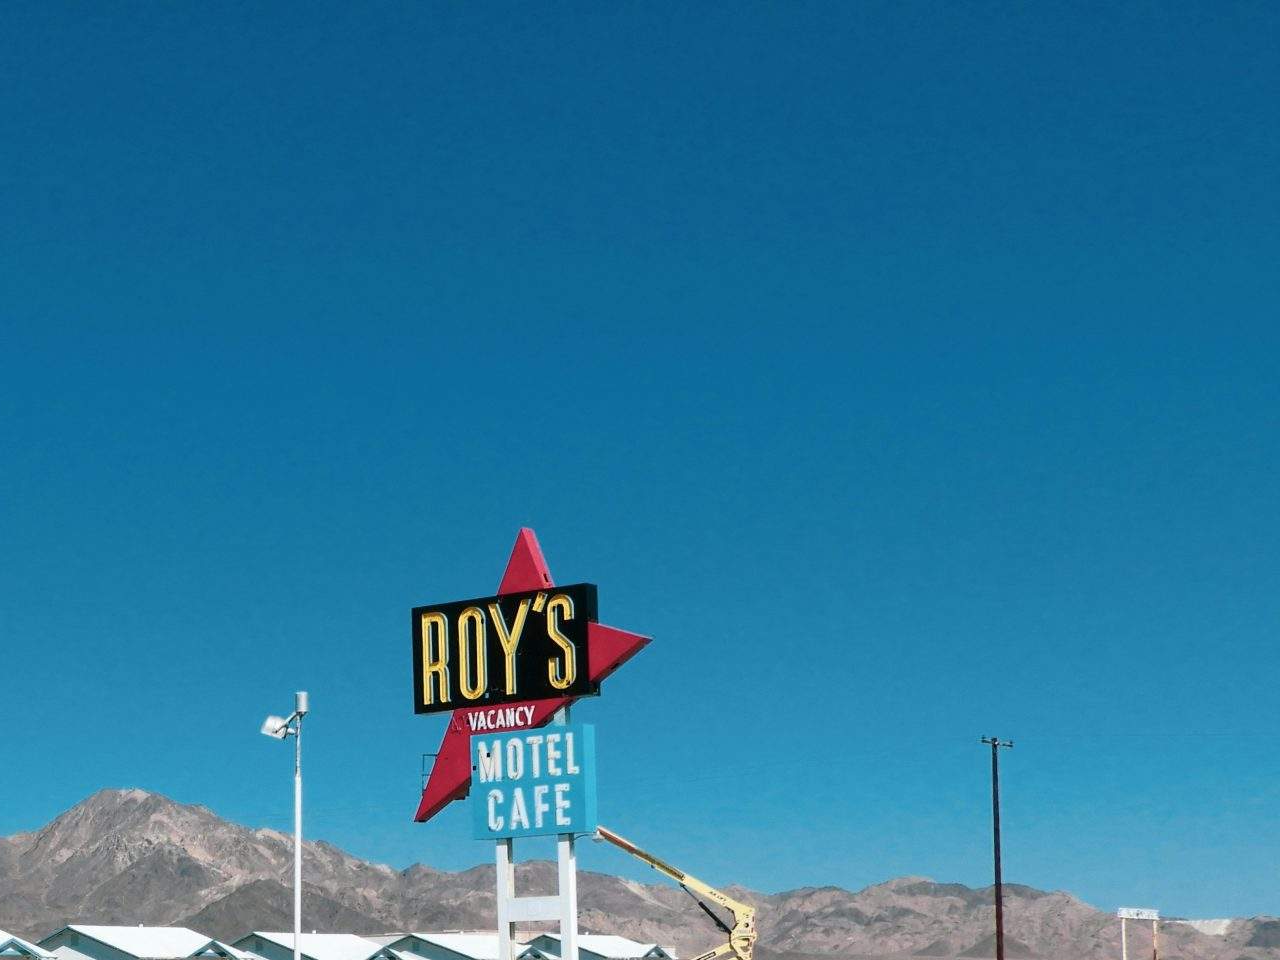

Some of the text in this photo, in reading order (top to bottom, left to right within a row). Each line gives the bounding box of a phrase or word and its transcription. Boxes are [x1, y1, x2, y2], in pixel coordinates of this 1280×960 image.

[421, 592, 577, 706] ROY'S
[468, 705, 535, 731] VACANCY
[477, 732, 580, 783] MOTEL
[487, 783, 572, 832] CAFE
